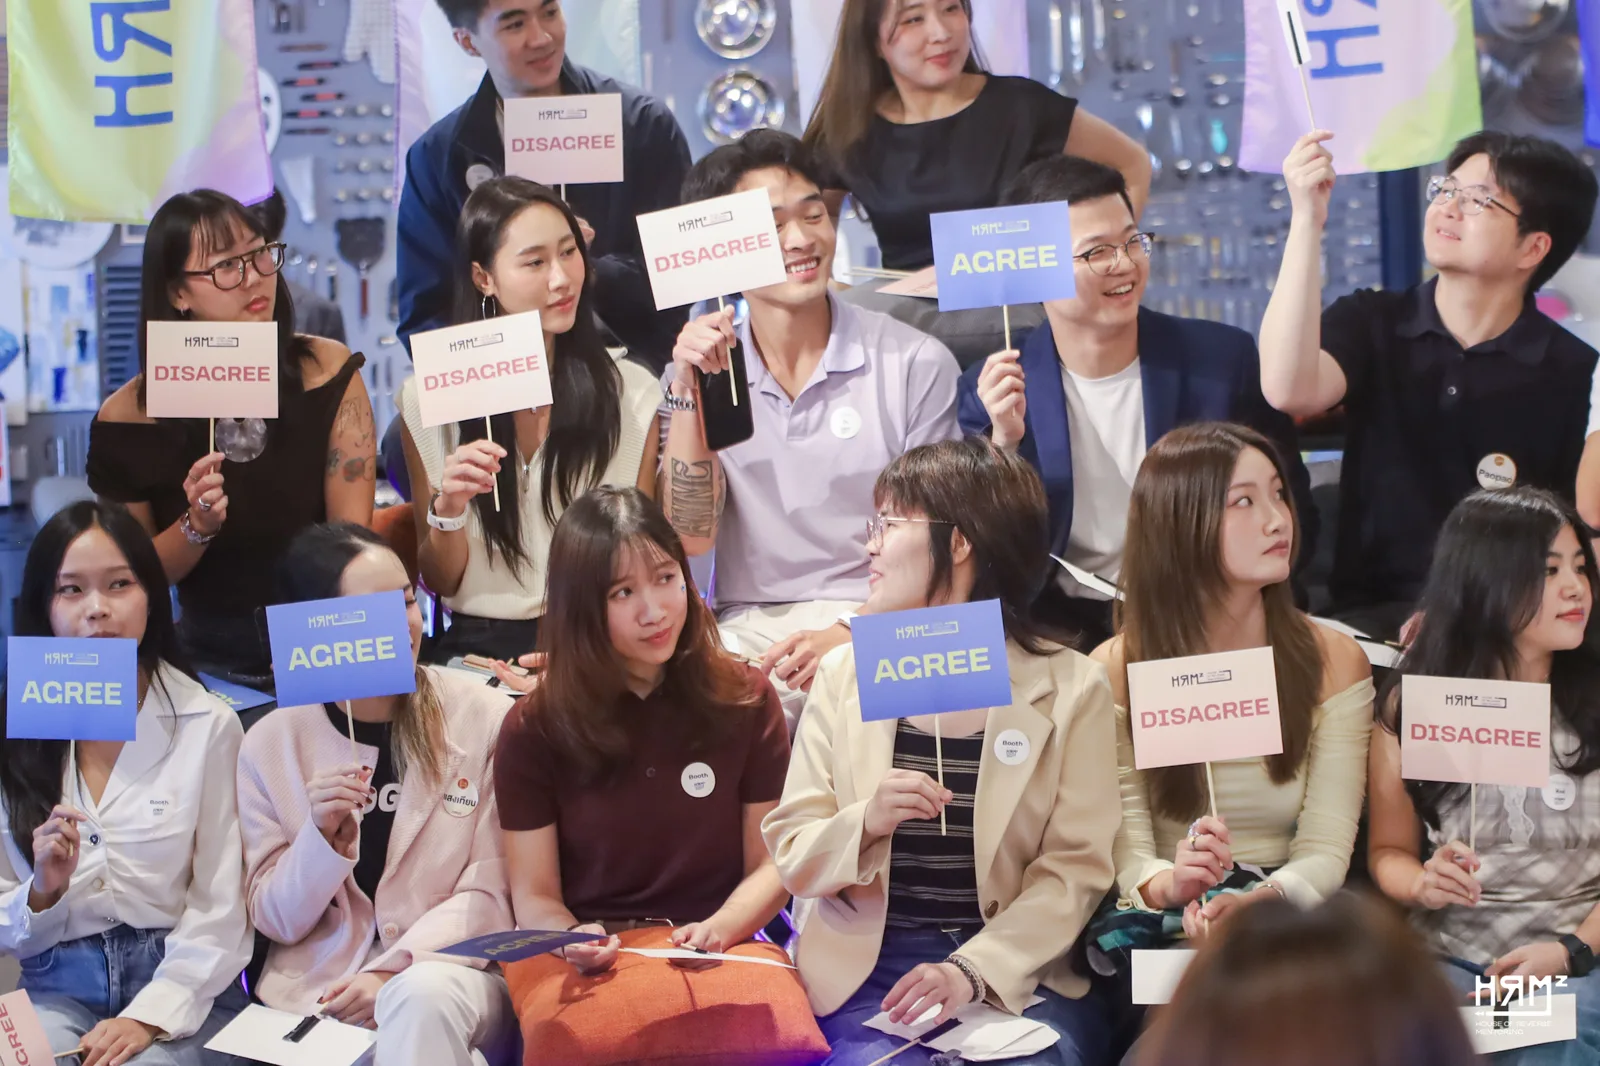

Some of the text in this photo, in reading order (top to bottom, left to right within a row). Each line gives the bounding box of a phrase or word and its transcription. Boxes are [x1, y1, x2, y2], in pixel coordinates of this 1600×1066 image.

[511, 134, 616, 153] DISAGREE
[654, 232, 772, 273] DISAGREE
[950, 244, 1059, 276] AGREE
[154, 365, 271, 382] DISAGREE
[423, 354, 540, 392] DISAGREE
[288, 635, 397, 672] AGREE
[873, 647, 992, 684] AGREE
[21, 680, 123, 706] AGREE
[1140, 697, 1271, 729] DISAGREE
[1410, 723, 1542, 749] DISAGREE
[688, 772, 709, 781] Booth
[0, 1003, 31, 1066] GREE
